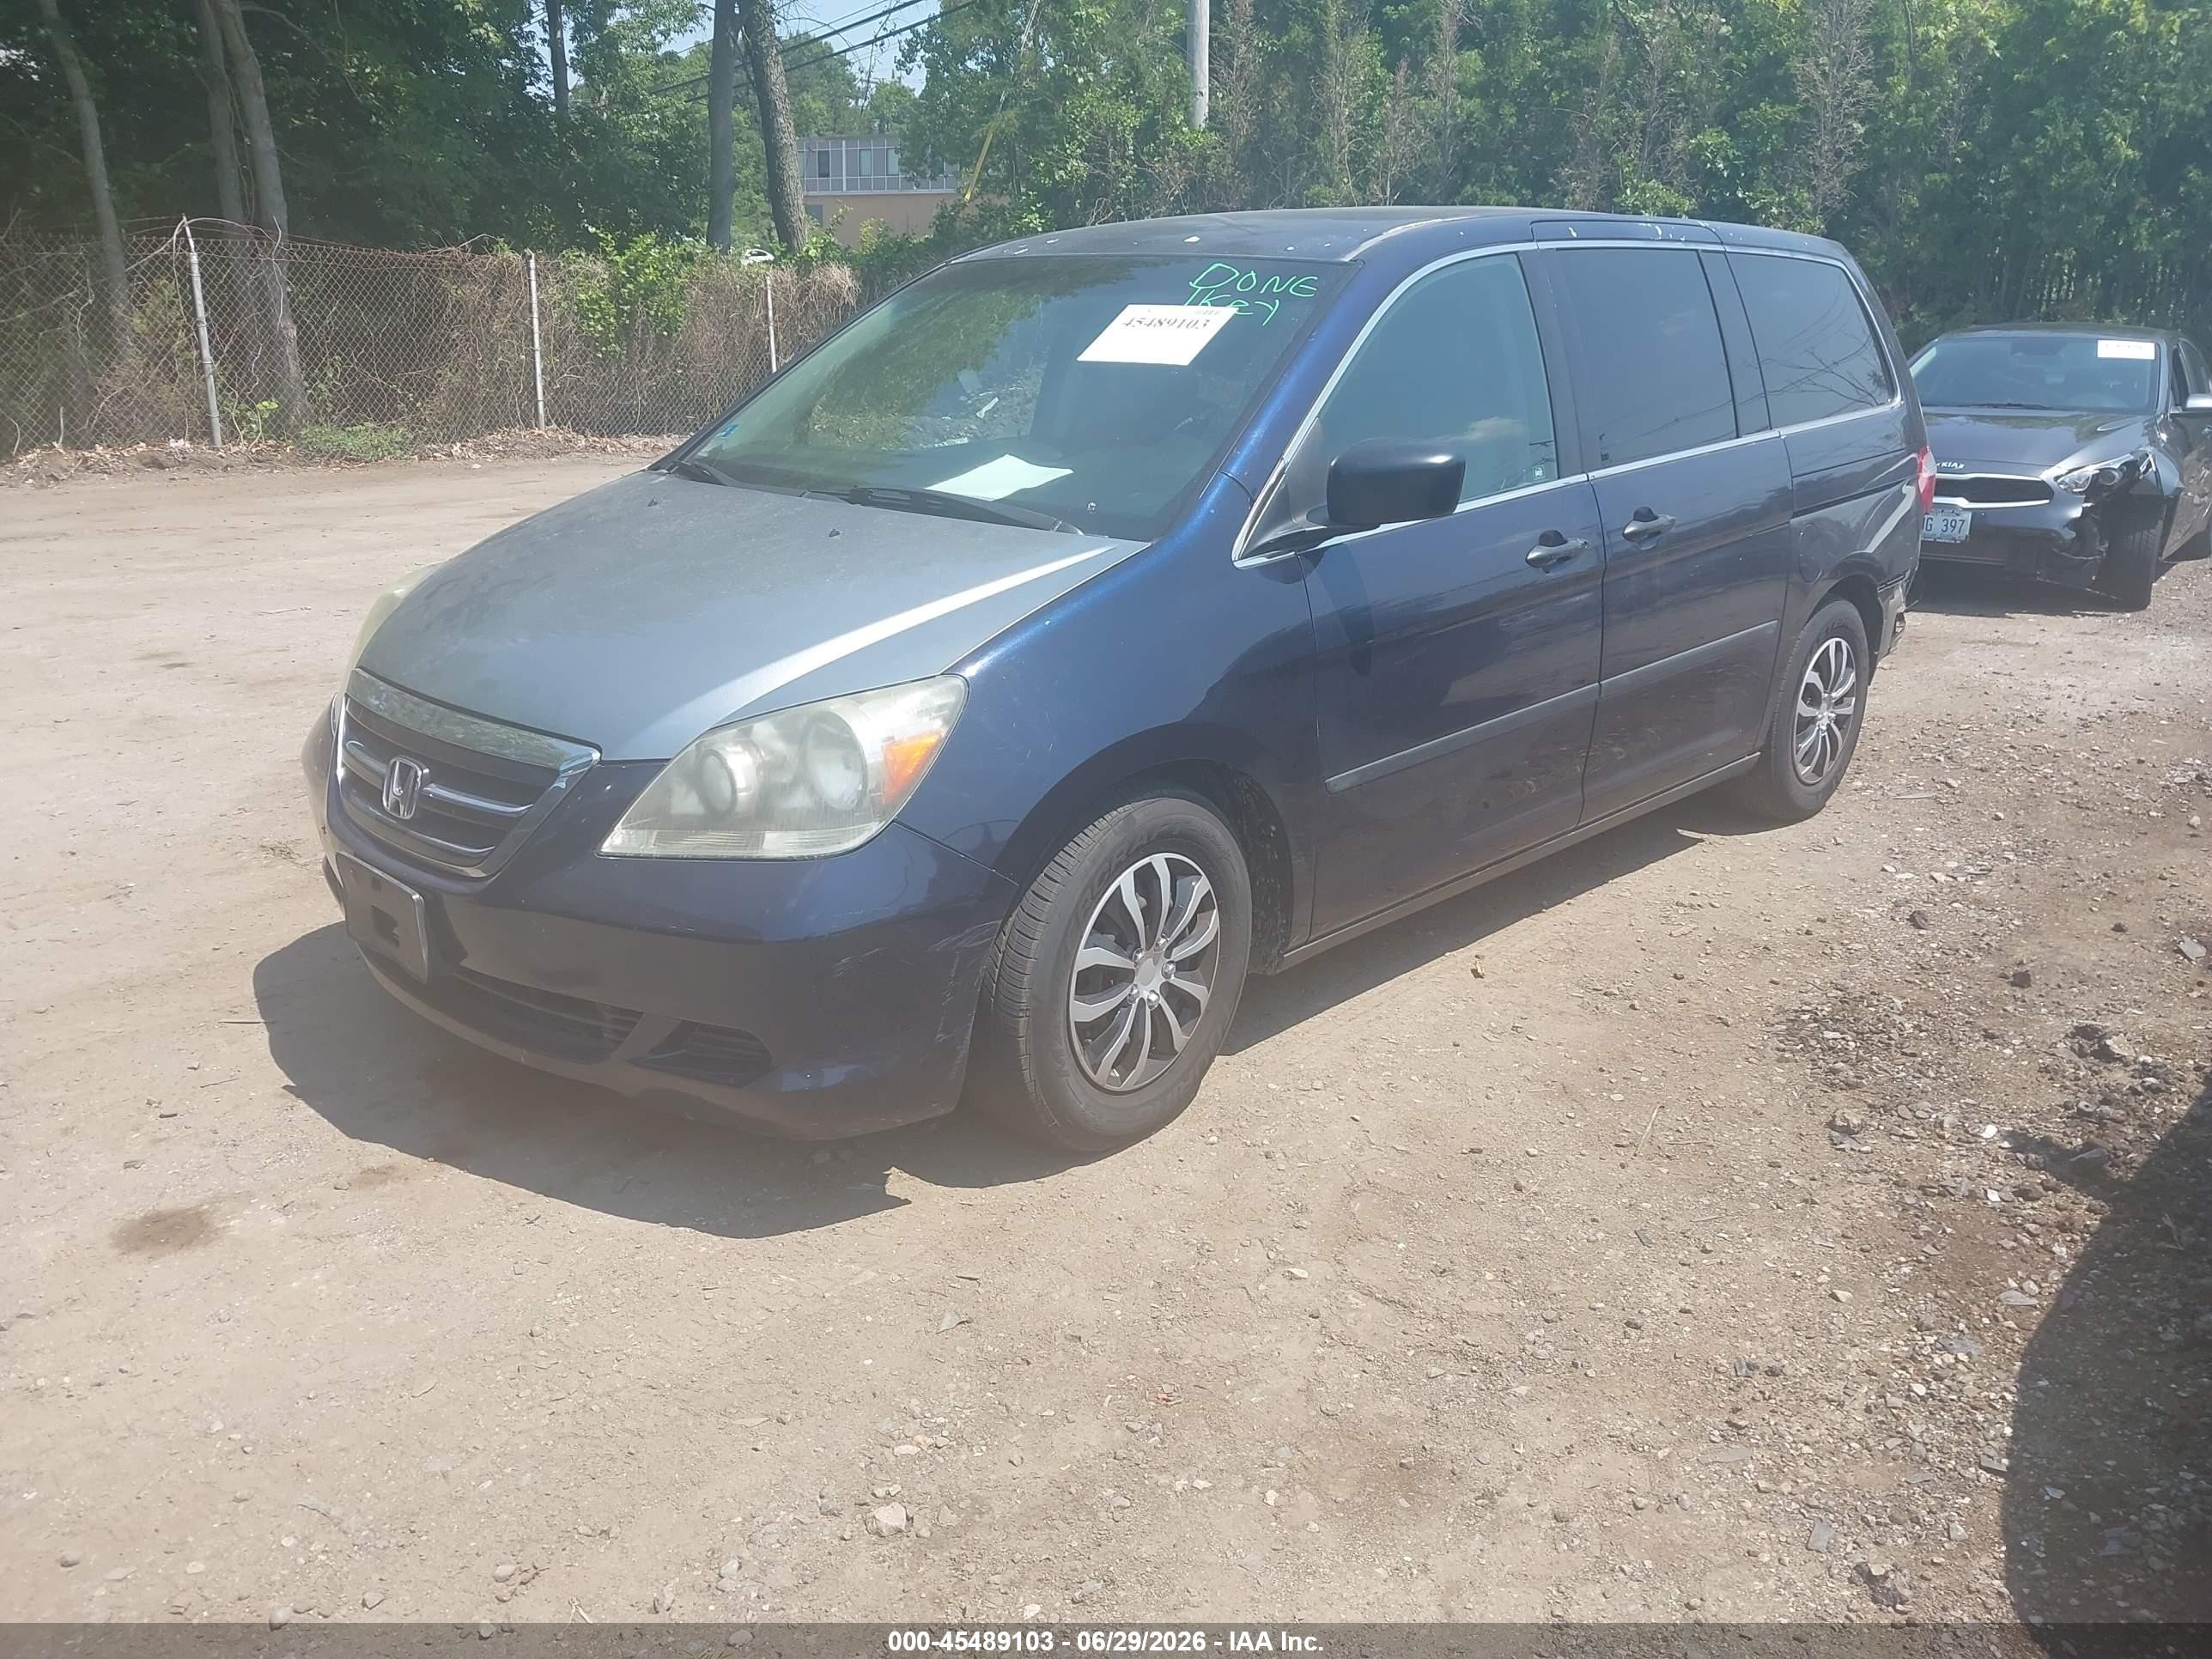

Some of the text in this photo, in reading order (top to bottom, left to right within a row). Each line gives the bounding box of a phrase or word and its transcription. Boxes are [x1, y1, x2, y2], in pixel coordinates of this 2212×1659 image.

[1188, 263, 1318, 296] DONE
[1122, 318, 1210, 330] 45489103
[1923, 517, 1966, 534] G 397
